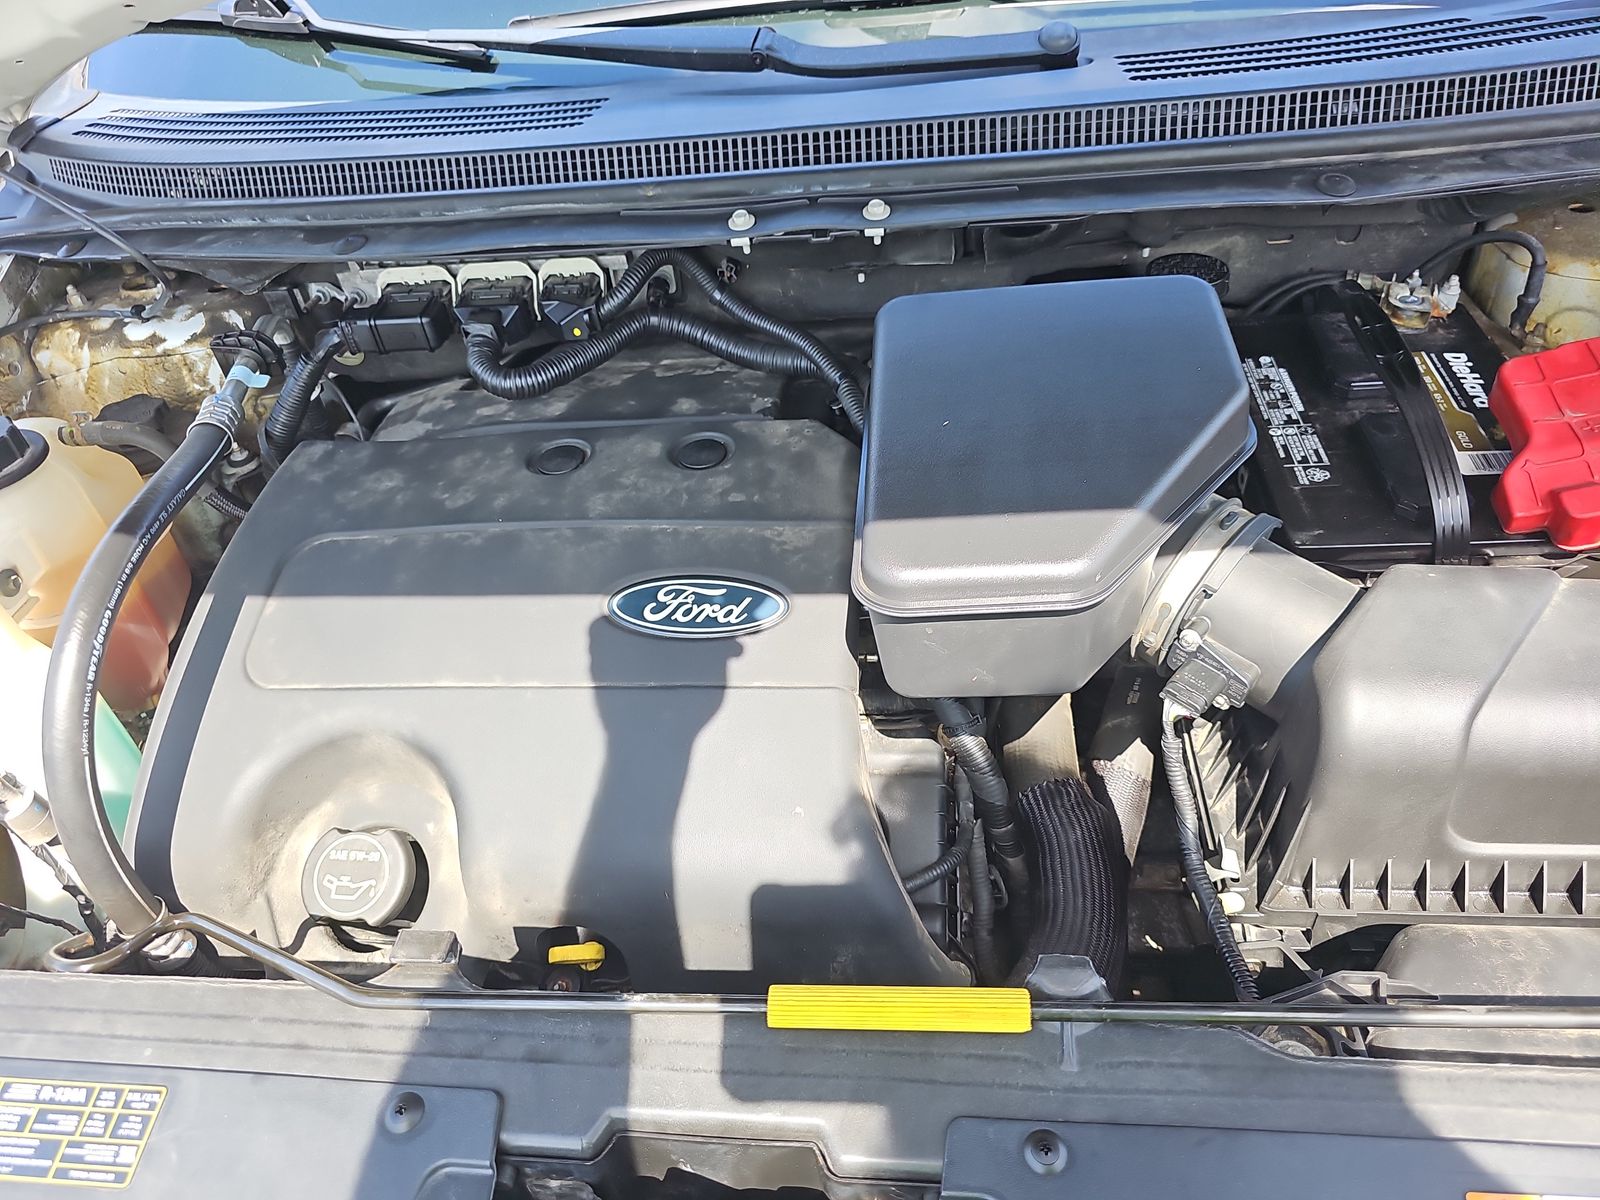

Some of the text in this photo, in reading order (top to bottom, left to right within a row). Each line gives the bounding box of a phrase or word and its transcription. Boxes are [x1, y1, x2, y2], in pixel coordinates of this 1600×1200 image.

[1443, 353, 1489, 408] DieHard
[1456, 430, 1473, 449] GOLD
[167, 488, 186, 514] GALAXY
[131, 543, 145, 564] HOSE
[142, 534, 151, 546] A/C
[108, 580, 124, 609] (16mm)
[643, 585, 753, 624] Ford
[87, 610, 112, 681] GOODYEAR
[83, 682, 93, 713] R-134a
[329, 849, 349, 861] SAE
